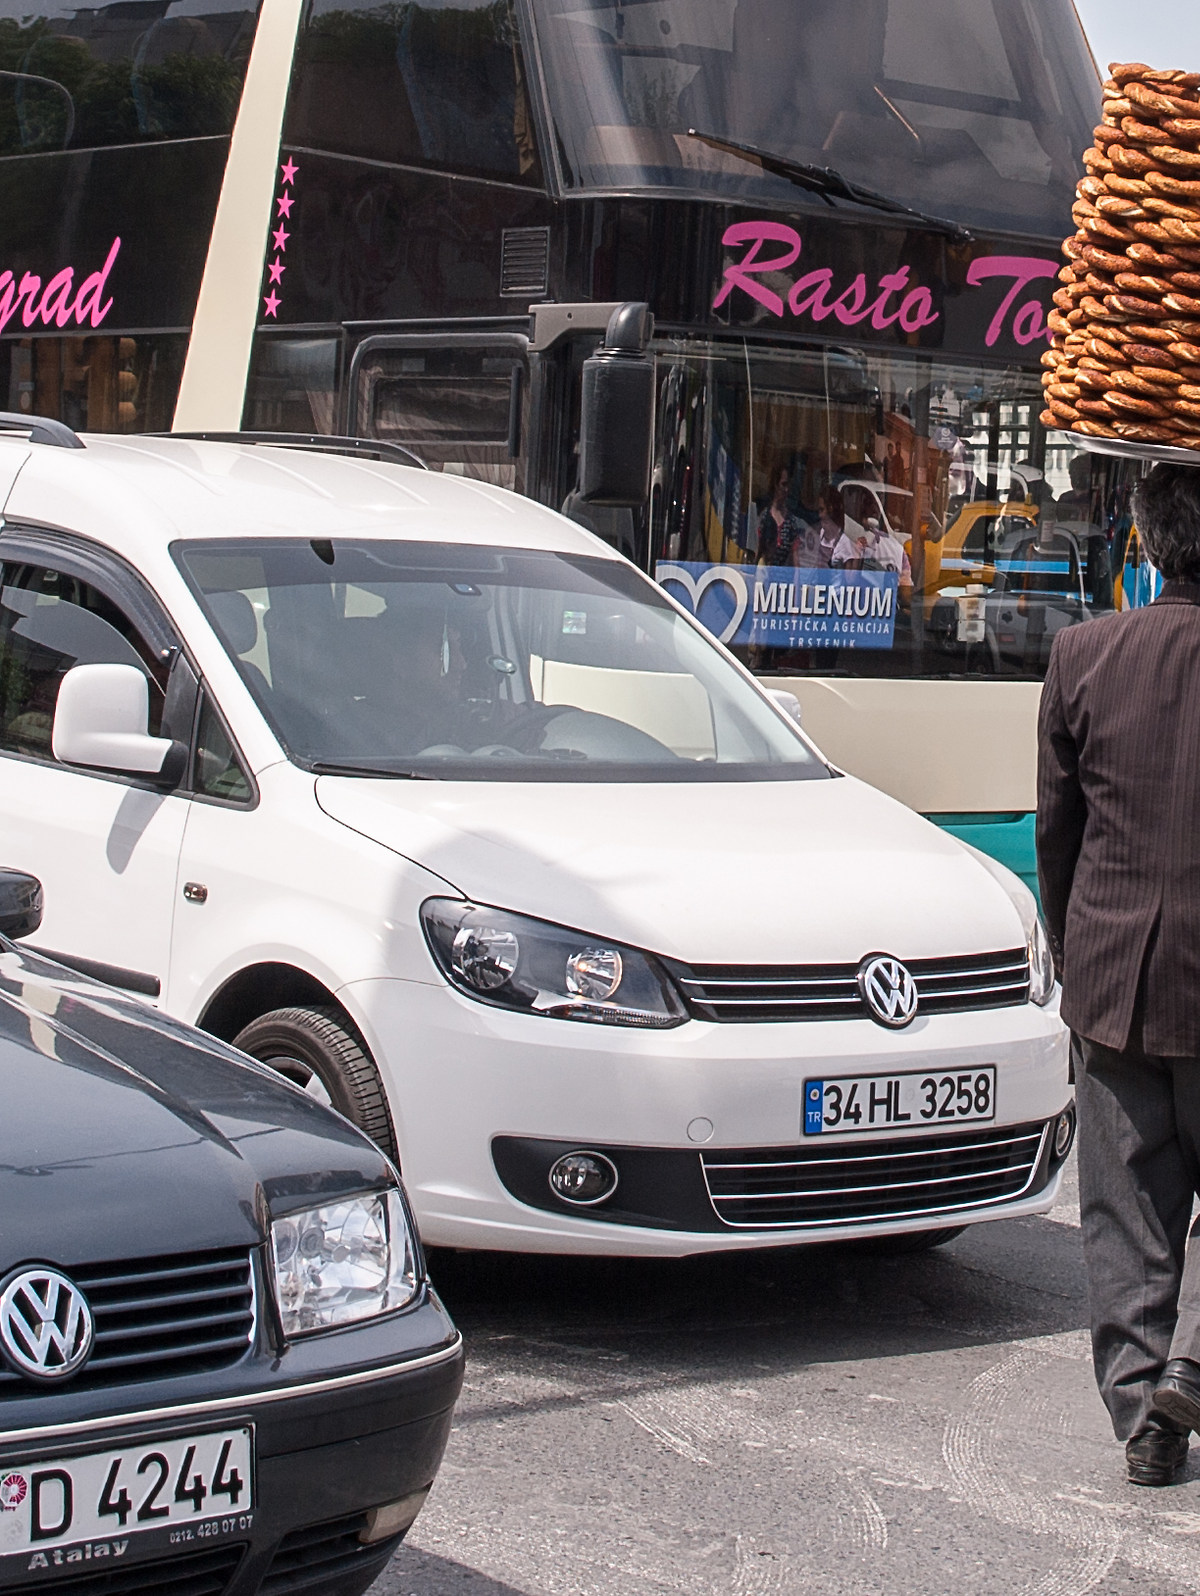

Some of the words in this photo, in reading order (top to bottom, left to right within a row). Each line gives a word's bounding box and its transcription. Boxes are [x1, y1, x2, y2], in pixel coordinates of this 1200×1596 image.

[713, 221, 939, 332] Rasto
[966, 256, 1060, 347] To
[753, 582, 892, 617] MILLENIUM
[753, 617, 828, 632] TURISTIČKA
[833, 622, 890, 634] AGENCIJA
[823, 1083, 862, 1126] 34
[869, 1080, 911, 1123] HL
[919, 1073, 990, 1119] 3258
[807, 1111, 821, 1124] TR
[30, 1468, 73, 1542] D
[98, 1439, 243, 1526] 4244
[197, 1522, 219, 1538] 428
[222, 1518, 236, 1533] 07
[239, 1515, 254, 1529] 07
[28, 1539, 129, 1570] Atalay
